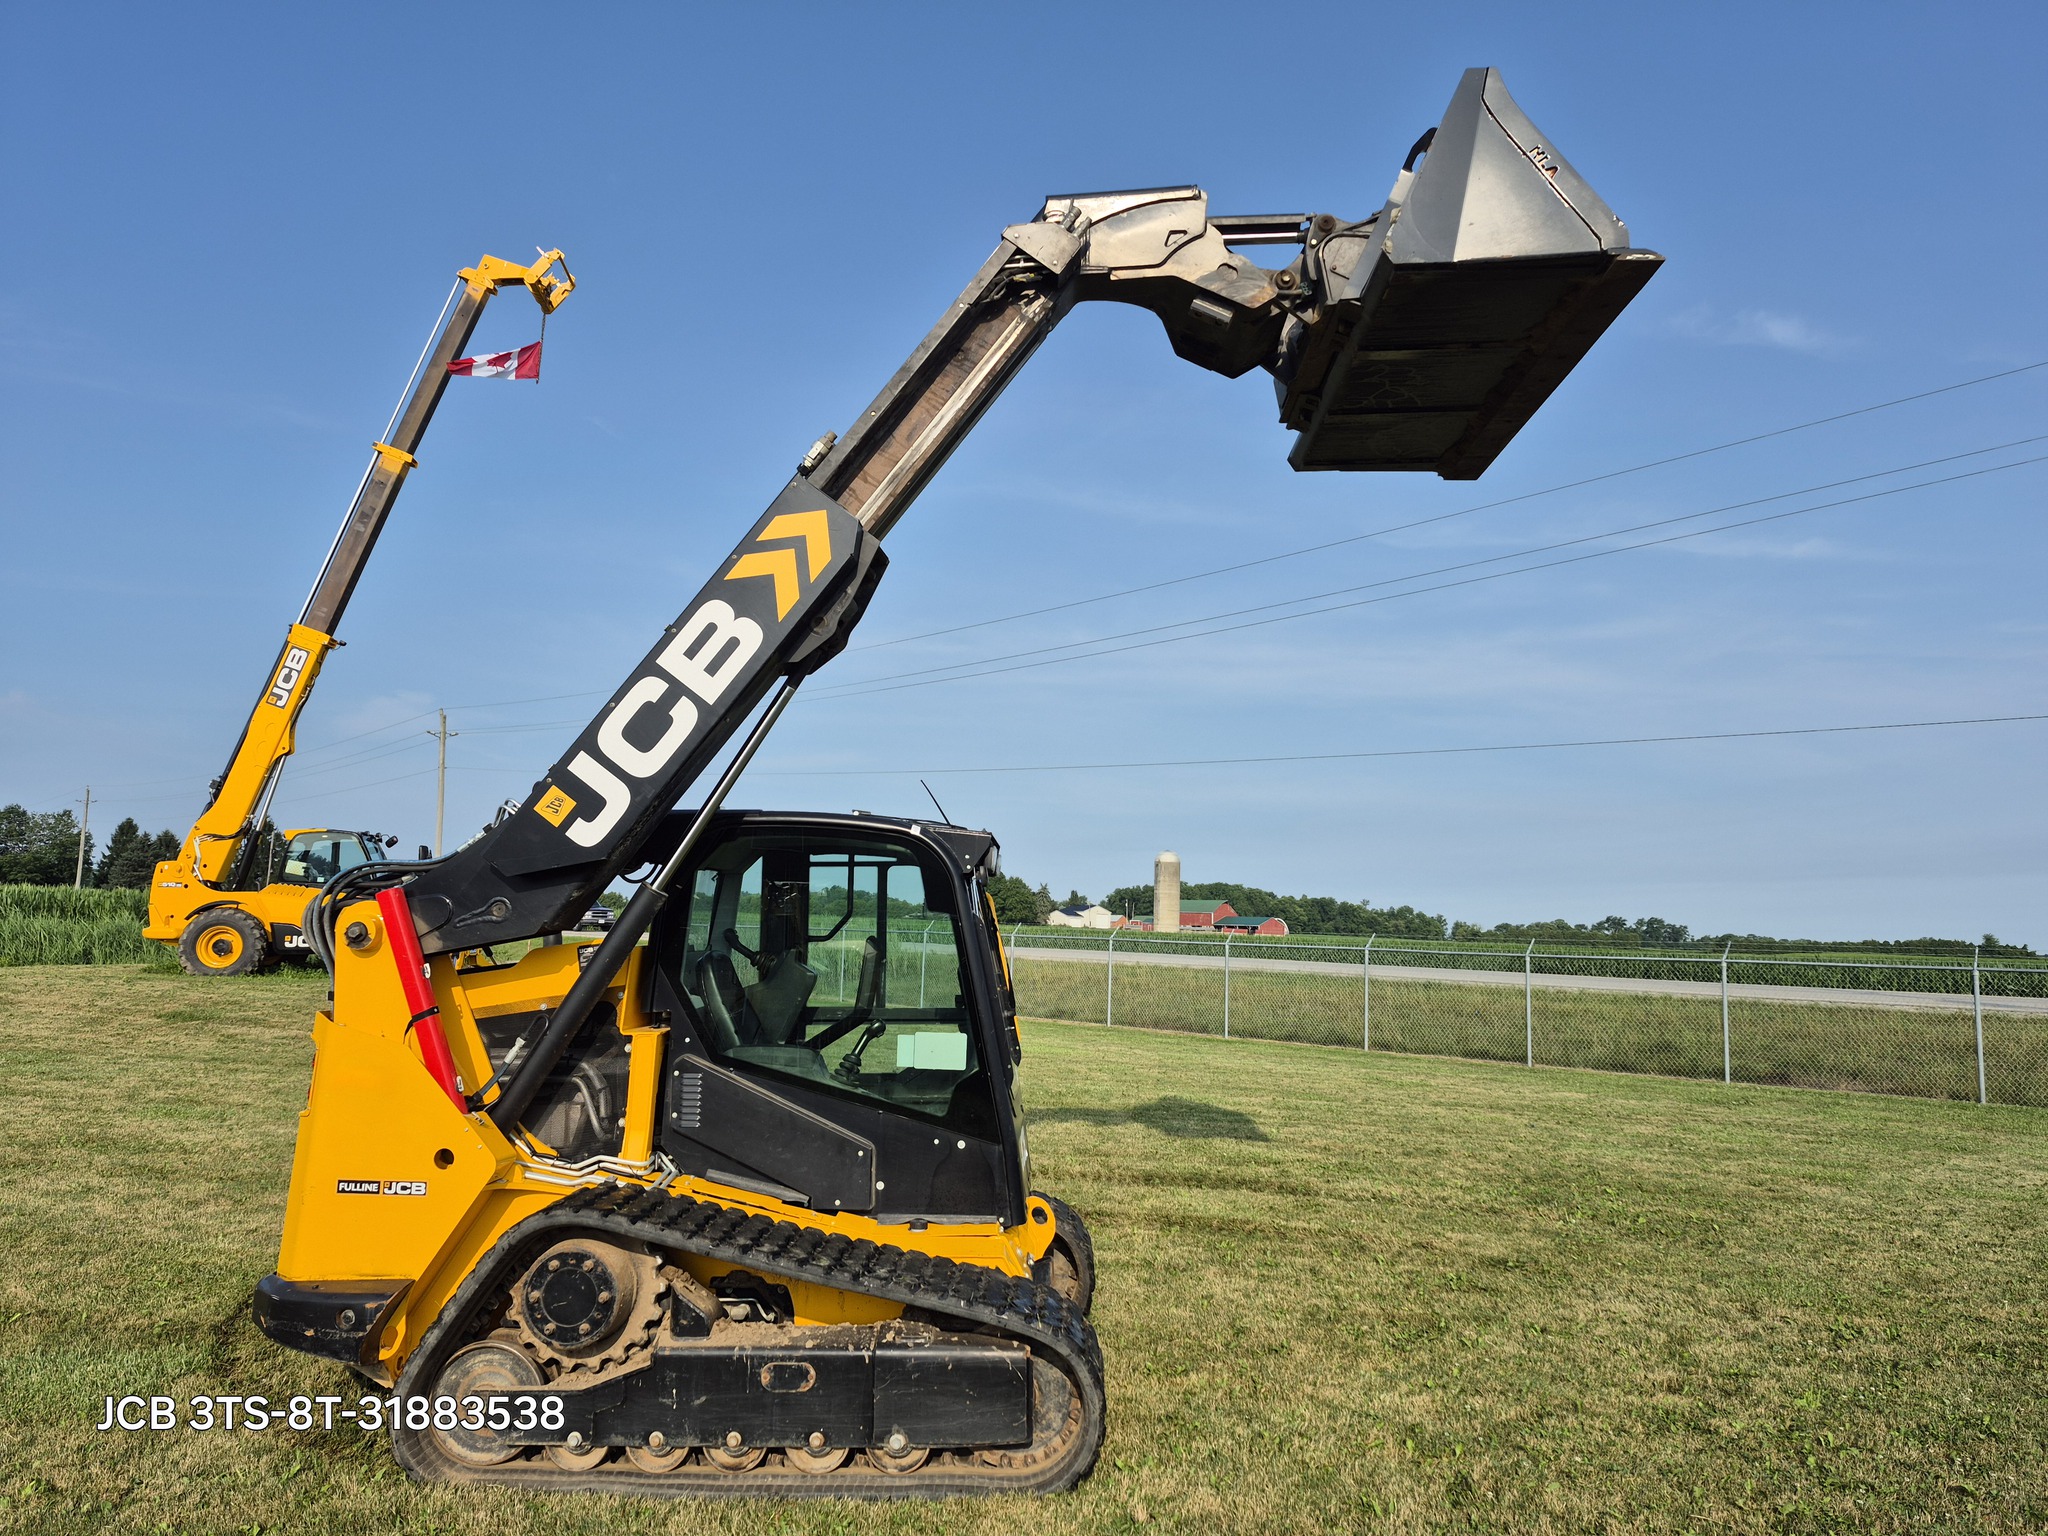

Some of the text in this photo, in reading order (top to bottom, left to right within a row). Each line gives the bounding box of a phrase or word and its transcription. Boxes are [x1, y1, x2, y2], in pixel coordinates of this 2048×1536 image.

[272, 648, 308, 707] JCB
[564, 599, 764, 848] JCB
[546, 797, 564, 814] JCB
[284, 935, 310, 948] JC
[338, 1181, 427, 1195] FULLINE JCB
